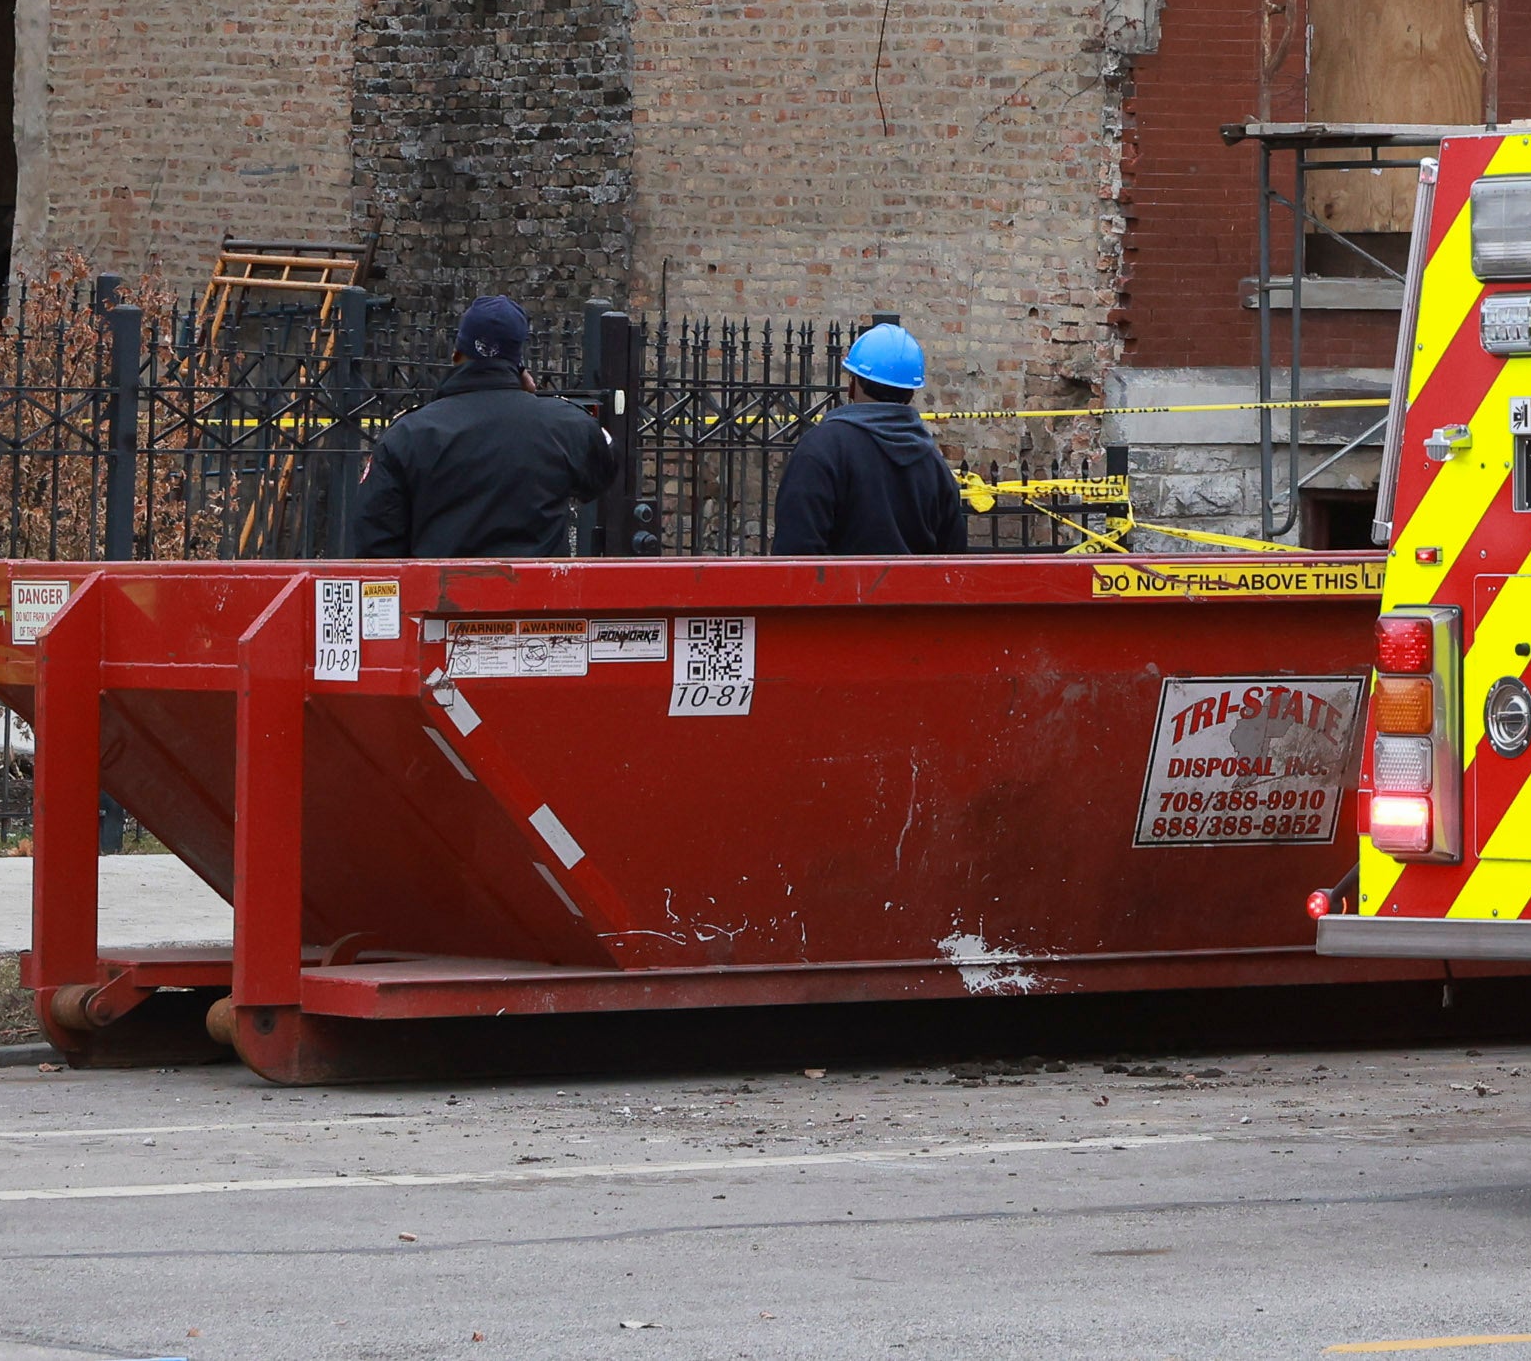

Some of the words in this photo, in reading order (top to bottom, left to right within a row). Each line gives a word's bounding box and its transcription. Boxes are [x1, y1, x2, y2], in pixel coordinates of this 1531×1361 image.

[368, 584, 397, 596] WARNING
[1100, 574, 1129, 592] DO
[1136, 574, 1176, 591] NOT
[1185, 574, 1230, 591] FILL
[1238, 573, 1307, 591] ABOVE
[1312, 573, 1358, 590] THIS
[1365, 572, 1385, 589] LI
[18, 588, 63, 606] DANGER
[16, 611, 21, 622] DO
[22, 611, 32, 622] NOT
[33, 611, 45, 622] PARK
[20, 626, 26, 637] OF
[27, 626, 36, 637] THIS
[532, 621, 583, 633] WARNING
[597, 629, 660, 645] IRONWORKS
[318, 648, 357, 672] 10-81
[677, 684, 751, 708] 10-81
[1171, 685, 1343, 746] TRI-STATE
[1167, 756, 1277, 778] DISPOSAL
[1285, 758, 1328, 777] INC.
[1159, 789, 1325, 814] 708/388-9910
[1151, 814, 1322, 838] 888/388-8352
